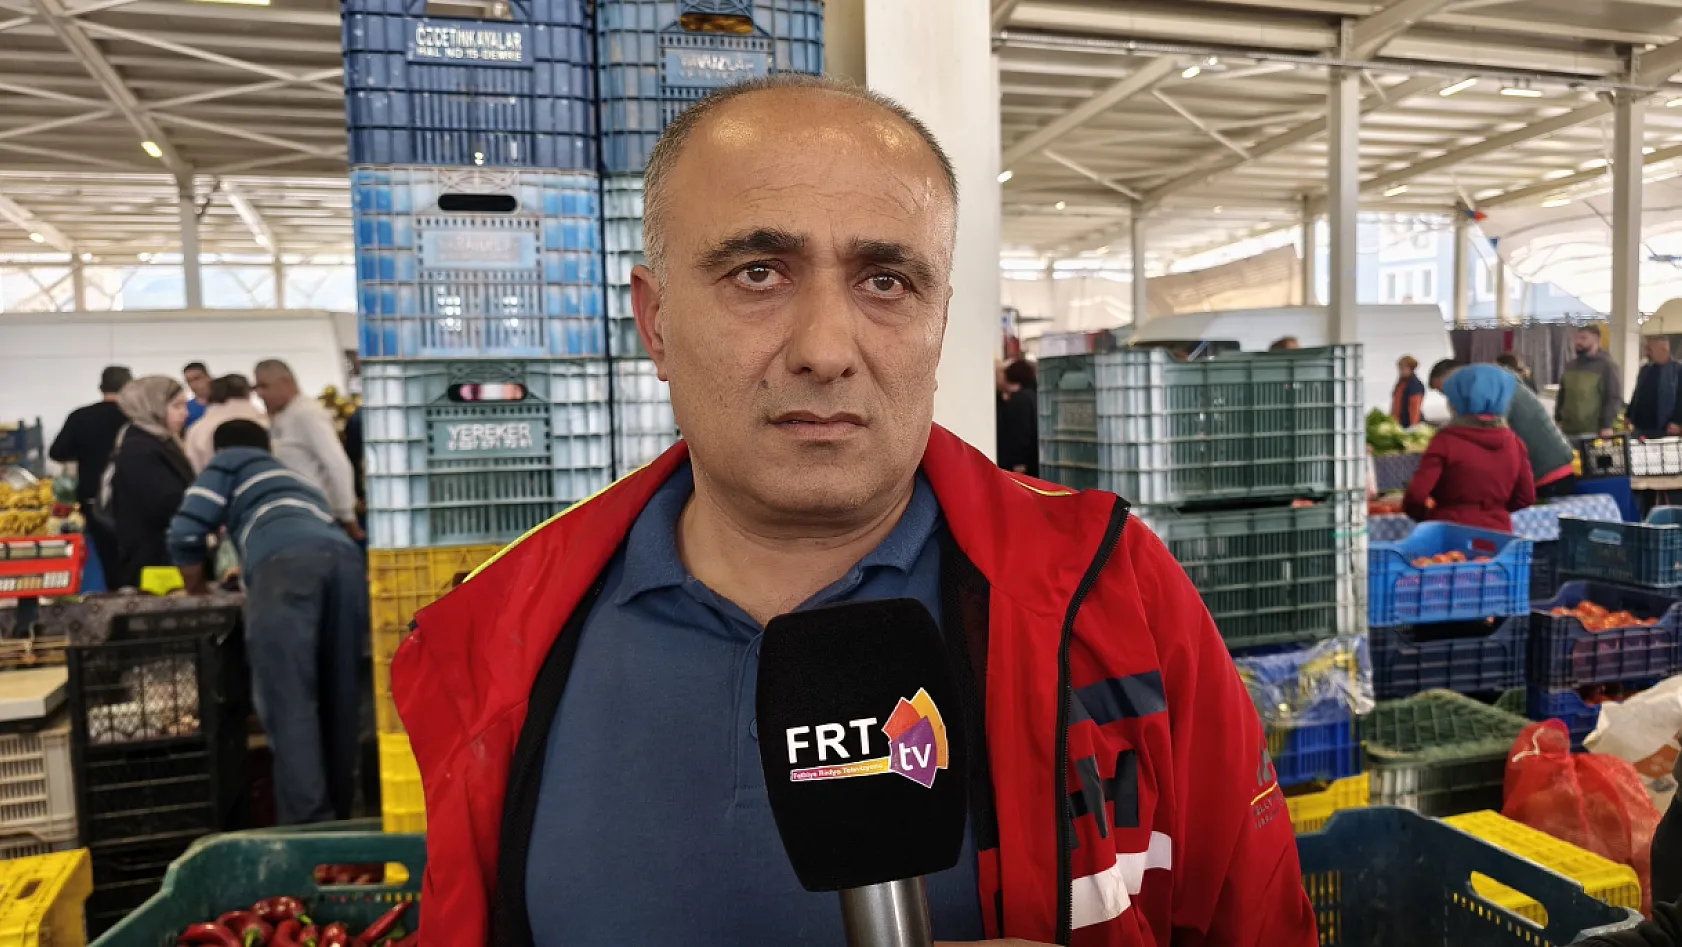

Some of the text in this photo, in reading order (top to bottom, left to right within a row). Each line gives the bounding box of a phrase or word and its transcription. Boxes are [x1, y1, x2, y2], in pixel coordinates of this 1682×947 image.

[447, 424, 531, 441] YEREKER
[786, 717, 877, 764] FRT
[899, 743, 931, 771] tv
